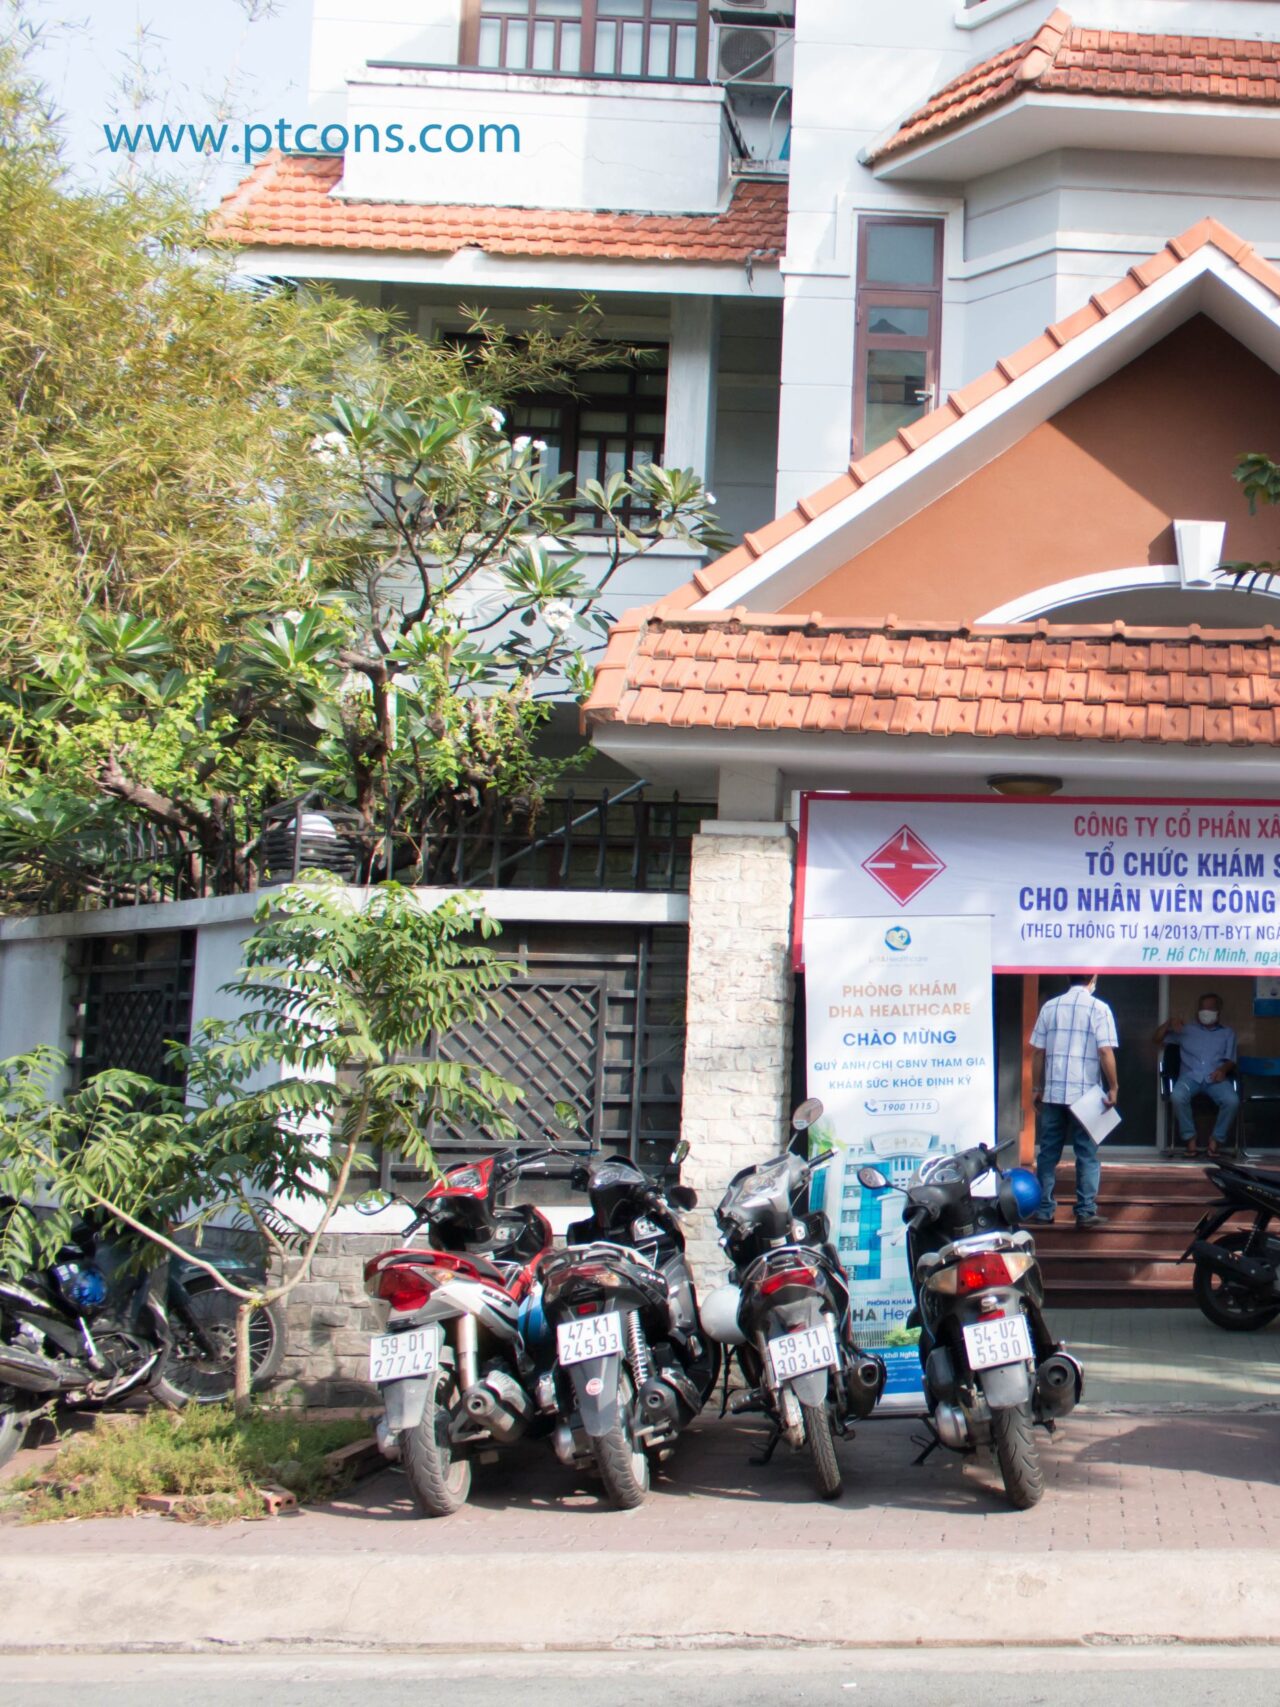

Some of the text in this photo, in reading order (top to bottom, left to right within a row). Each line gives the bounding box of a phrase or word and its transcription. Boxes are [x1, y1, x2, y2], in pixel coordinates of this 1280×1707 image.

[1073, 811, 1128, 838] CÔNG
[1134, 816, 1159, 838] TY
[1165, 808, 1191, 839] CỔ
[1197, 810, 1251, 839] PHẦN
[1085, 841, 1115, 876] TỔ
[1123, 846, 1189, 877] CHỨC
[1197, 847, 1265, 877] KHÁM
[1019, 886, 1068, 912] CHO
[1077, 882, 1141, 912] NHÂN
[1150, 883, 1203, 913] VIÊN
[1212, 883, 1276, 914] CÔNG
[1020, 923, 1063, 942] (THEO
[1067, 921, 1115, 940] THÔNG
[1120, 923, 1139, 940] TƯ
[1144, 924, 1252, 942] 14/2013/TT-BYT
[1141, 947, 1161, 962] TP.
[1189, 947, 1210, 962] Chí
[1213, 948, 1249, 965] Minh,
[842, 980, 958, 998] PHÒNG KHÁM
[828, 1002, 972, 1019] DHA HEALTHCARE
[843, 1027, 958, 1047] CHÀO MỪNG
[814, 1057, 986, 1072] QUÝ ANH/CHỊ CBNV THAM GIA
[828, 1077, 864, 1090] KHÁM
[866, 1077, 889, 1089] SỨC
[926, 1076, 954, 1090] ĐỊNH
[957, 1074, 972, 1086] KỲ
[882, 1102, 905, 1112] 1900
[567, 1317, 610, 1341] 47-K1
[972, 1321, 1018, 1345] 54-U2
[562, 1334, 619, 1361] 245.93
[778, 1333, 822, 1355] 59-T1
[978, 1340, 1022, 1366] 5590
[373, 1352, 434, 1379] 277.42
[777, 1345, 832, 1377] 303.40
